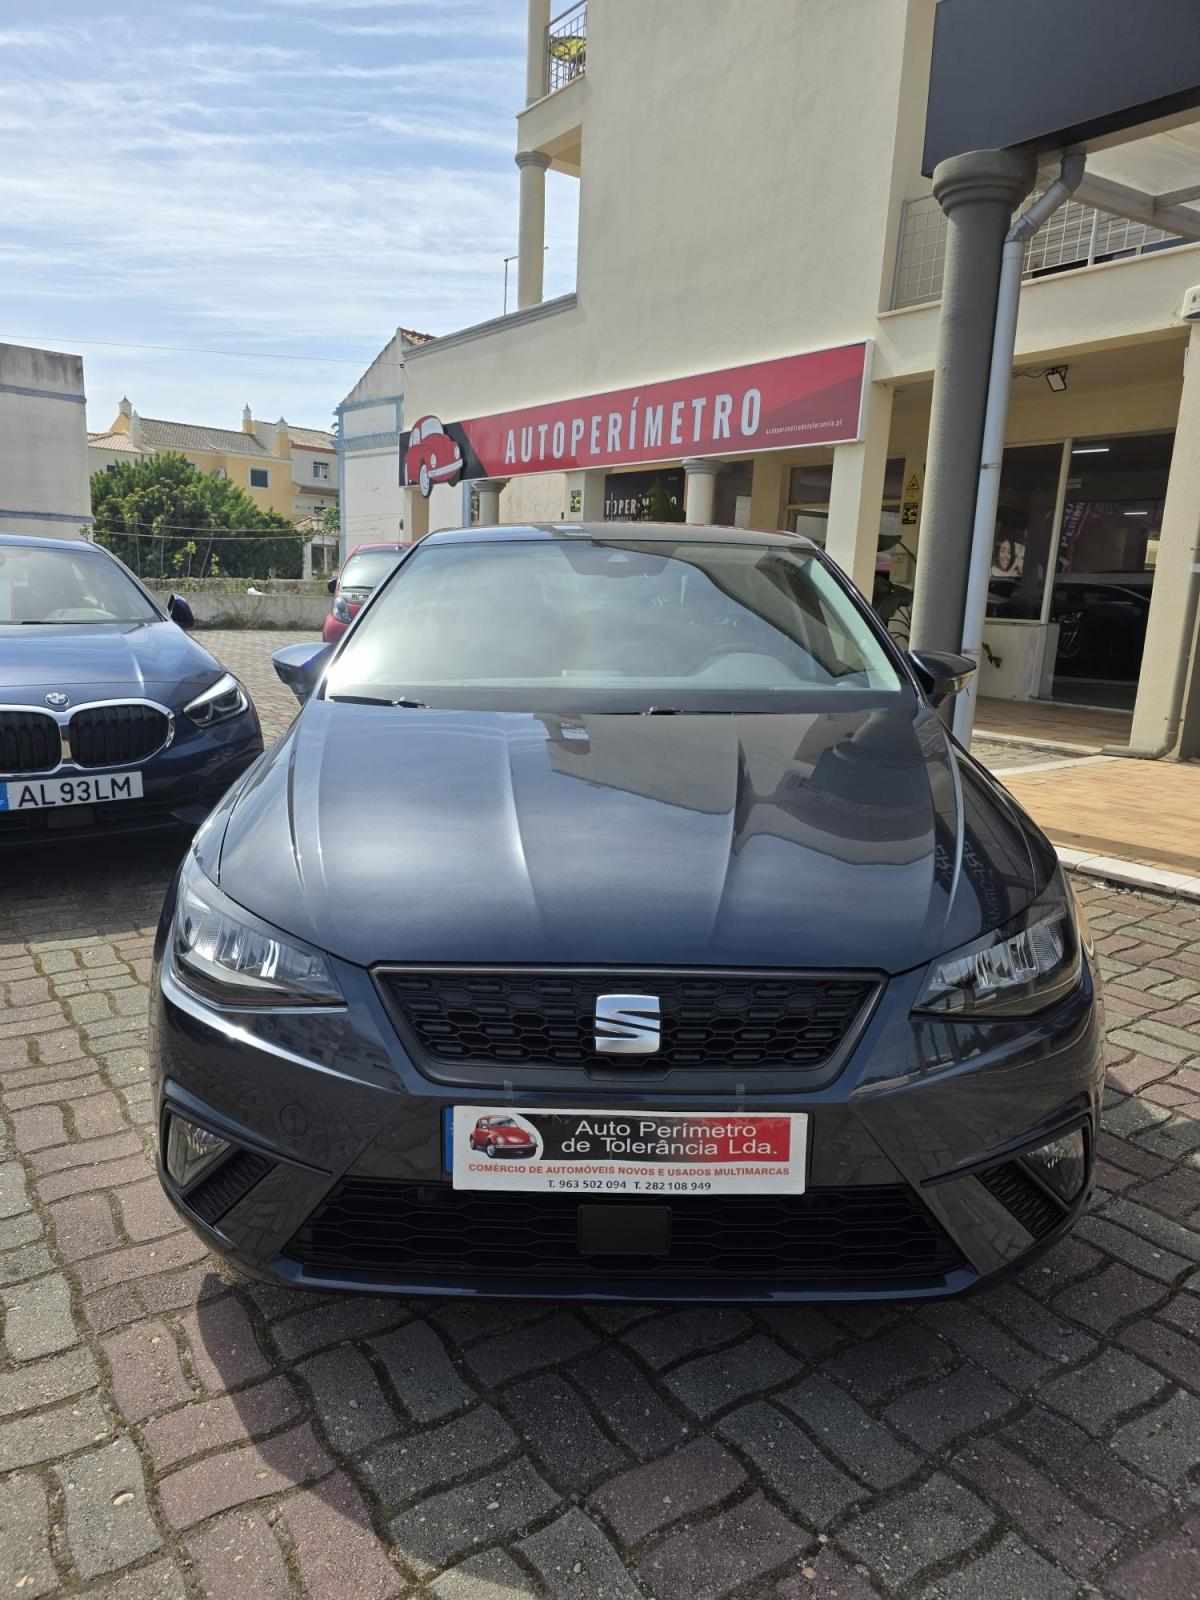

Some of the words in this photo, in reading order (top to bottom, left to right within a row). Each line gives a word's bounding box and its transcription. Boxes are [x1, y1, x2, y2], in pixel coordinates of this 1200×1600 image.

[504, 388, 761, 465] AUTOPERÍMETRO
[575, 1120, 631, 1136] Auto
[639, 1121, 757, 1139] Perímetro
[561, 1137, 592, 1153] de
[600, 1137, 719, 1156] Tolerância
[728, 1139, 777, 1155] Lda.
[468, 1163, 526, 1174] COMÉRCIO
[528, 1165, 544, 1174] DE
[545, 1163, 615, 1175] AUTOMÓVEIS
[618, 1166, 655, 1176] NOVOS
[657, 1168, 665, 1177] E
[667, 1168, 711, 1177] USADOS
[714, 1167, 790, 1177] MULTIMARCAS
[548, 1179, 556, 1188] T.
[559, 1179, 579, 1189] 963
[583, 1180, 602, 1189] 502
[606, 1180, 627, 1189] 094
[634, 1181, 641, 1190] T.
[645, 1181, 665, 1191] 282
[668, 1182, 688, 1191] 108
[690, 1182, 712, 1191] 949
